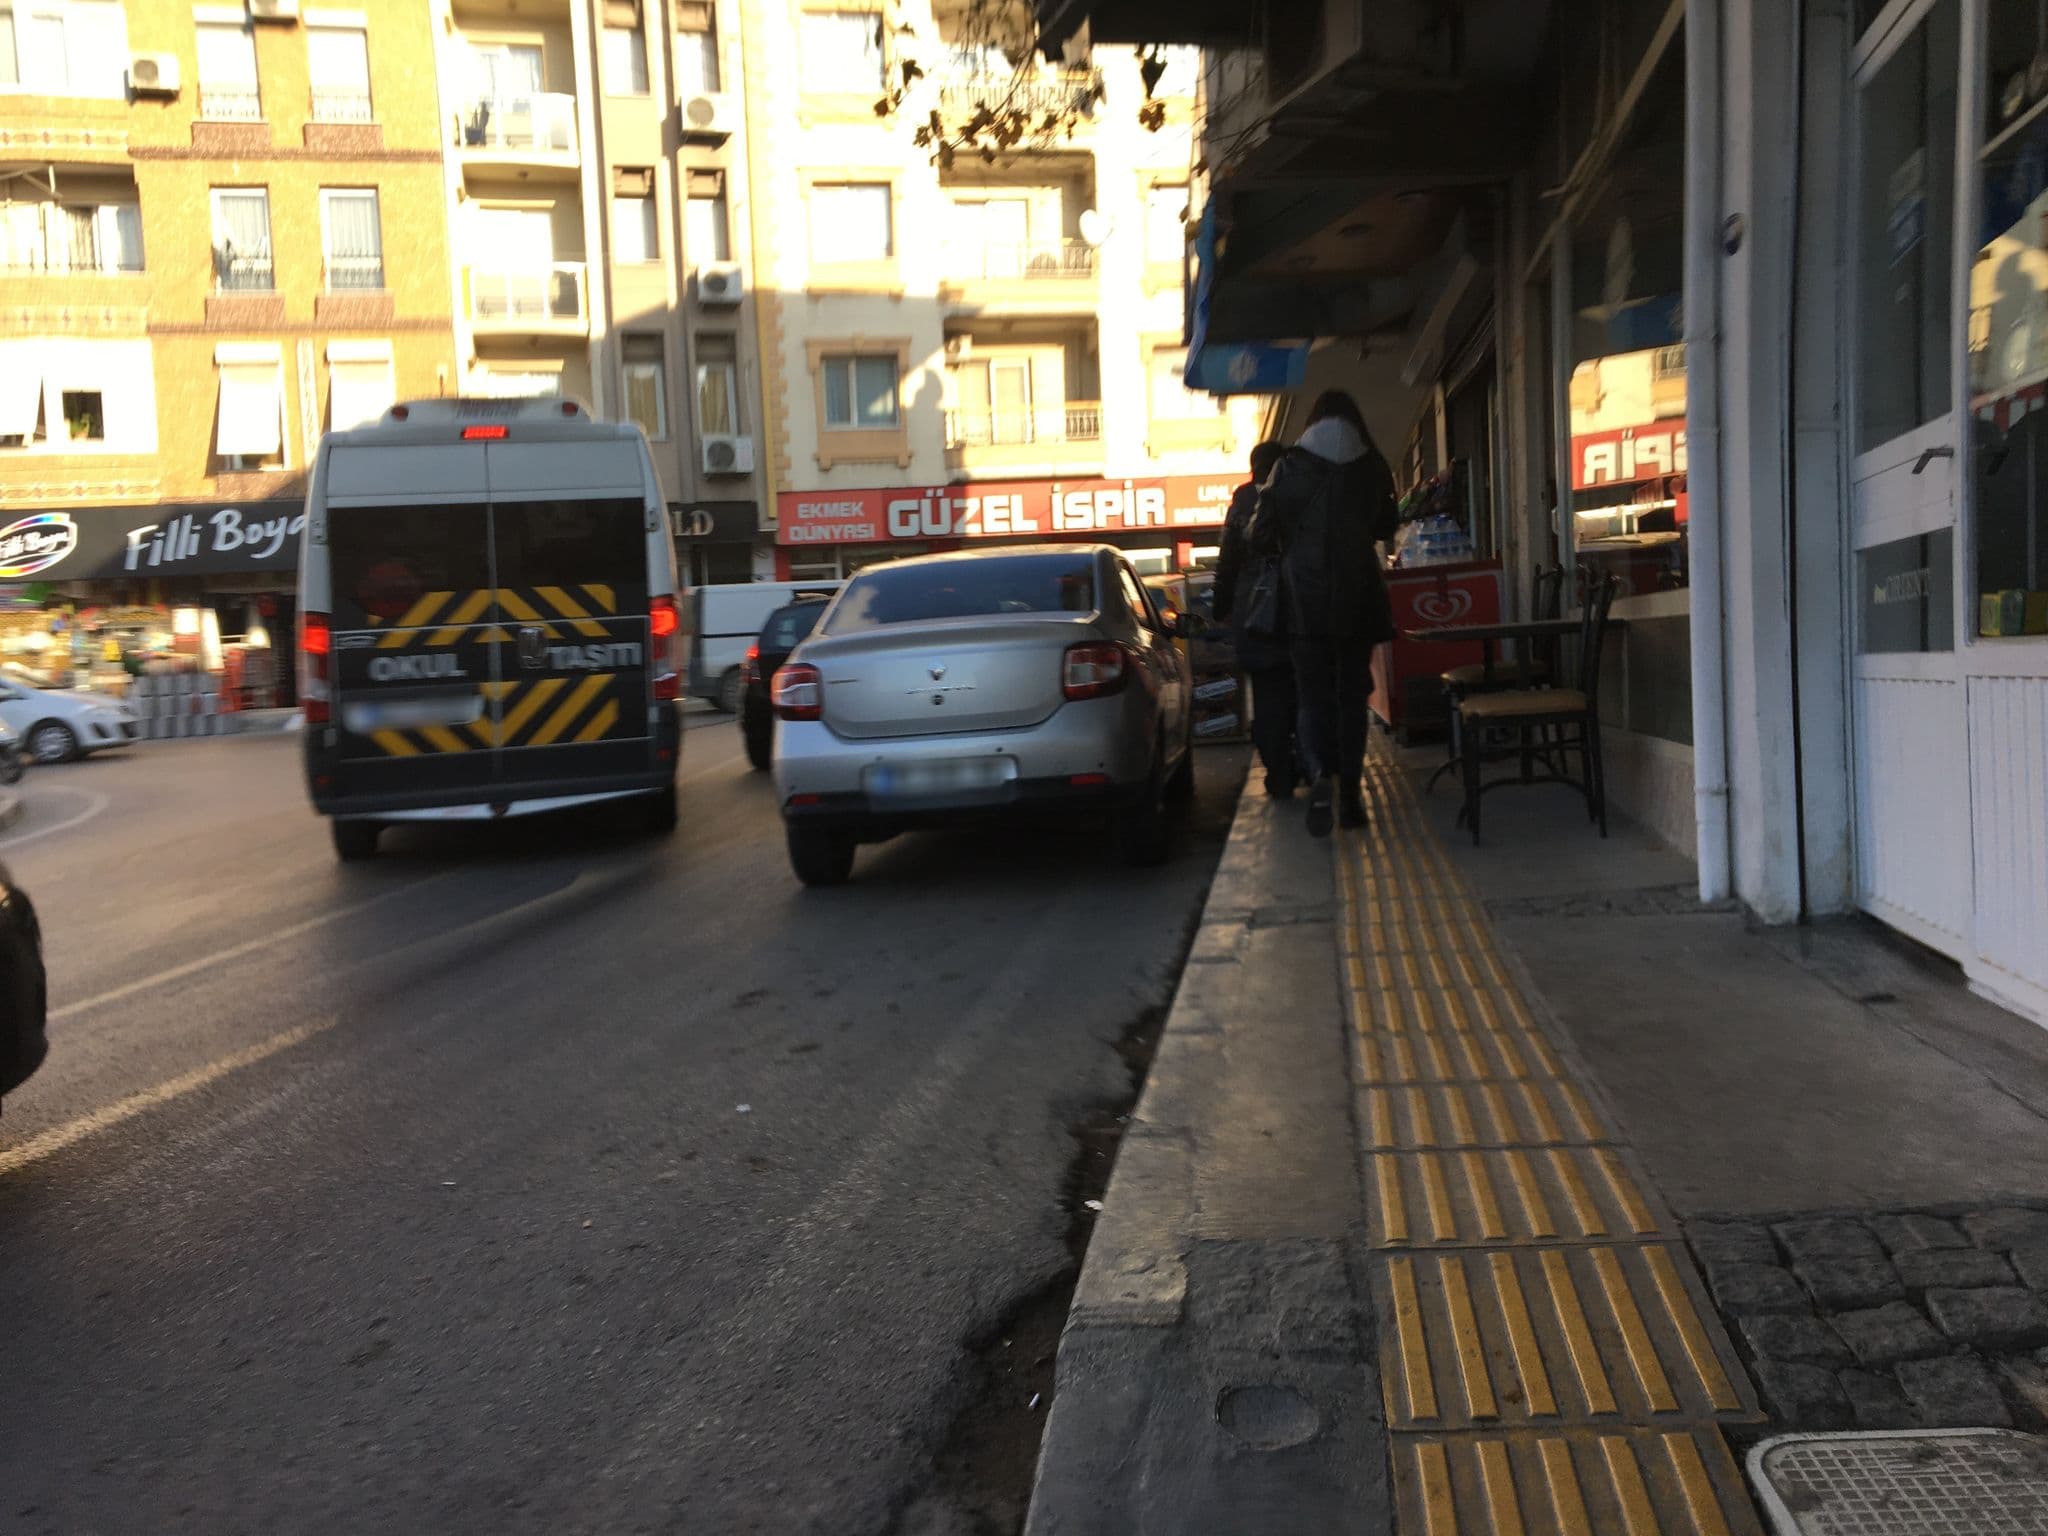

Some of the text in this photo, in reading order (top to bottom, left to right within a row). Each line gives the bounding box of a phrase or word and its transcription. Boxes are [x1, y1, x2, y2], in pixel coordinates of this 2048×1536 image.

[797, 501, 864, 519] EKMEK
[888, 480, 1166, 537] GÜZEL İSPİR
[124, 509, 306, 570] Filli Boya
[789, 522, 875, 541] DÜNYASI
[368, 653, 469, 682] OKUL
